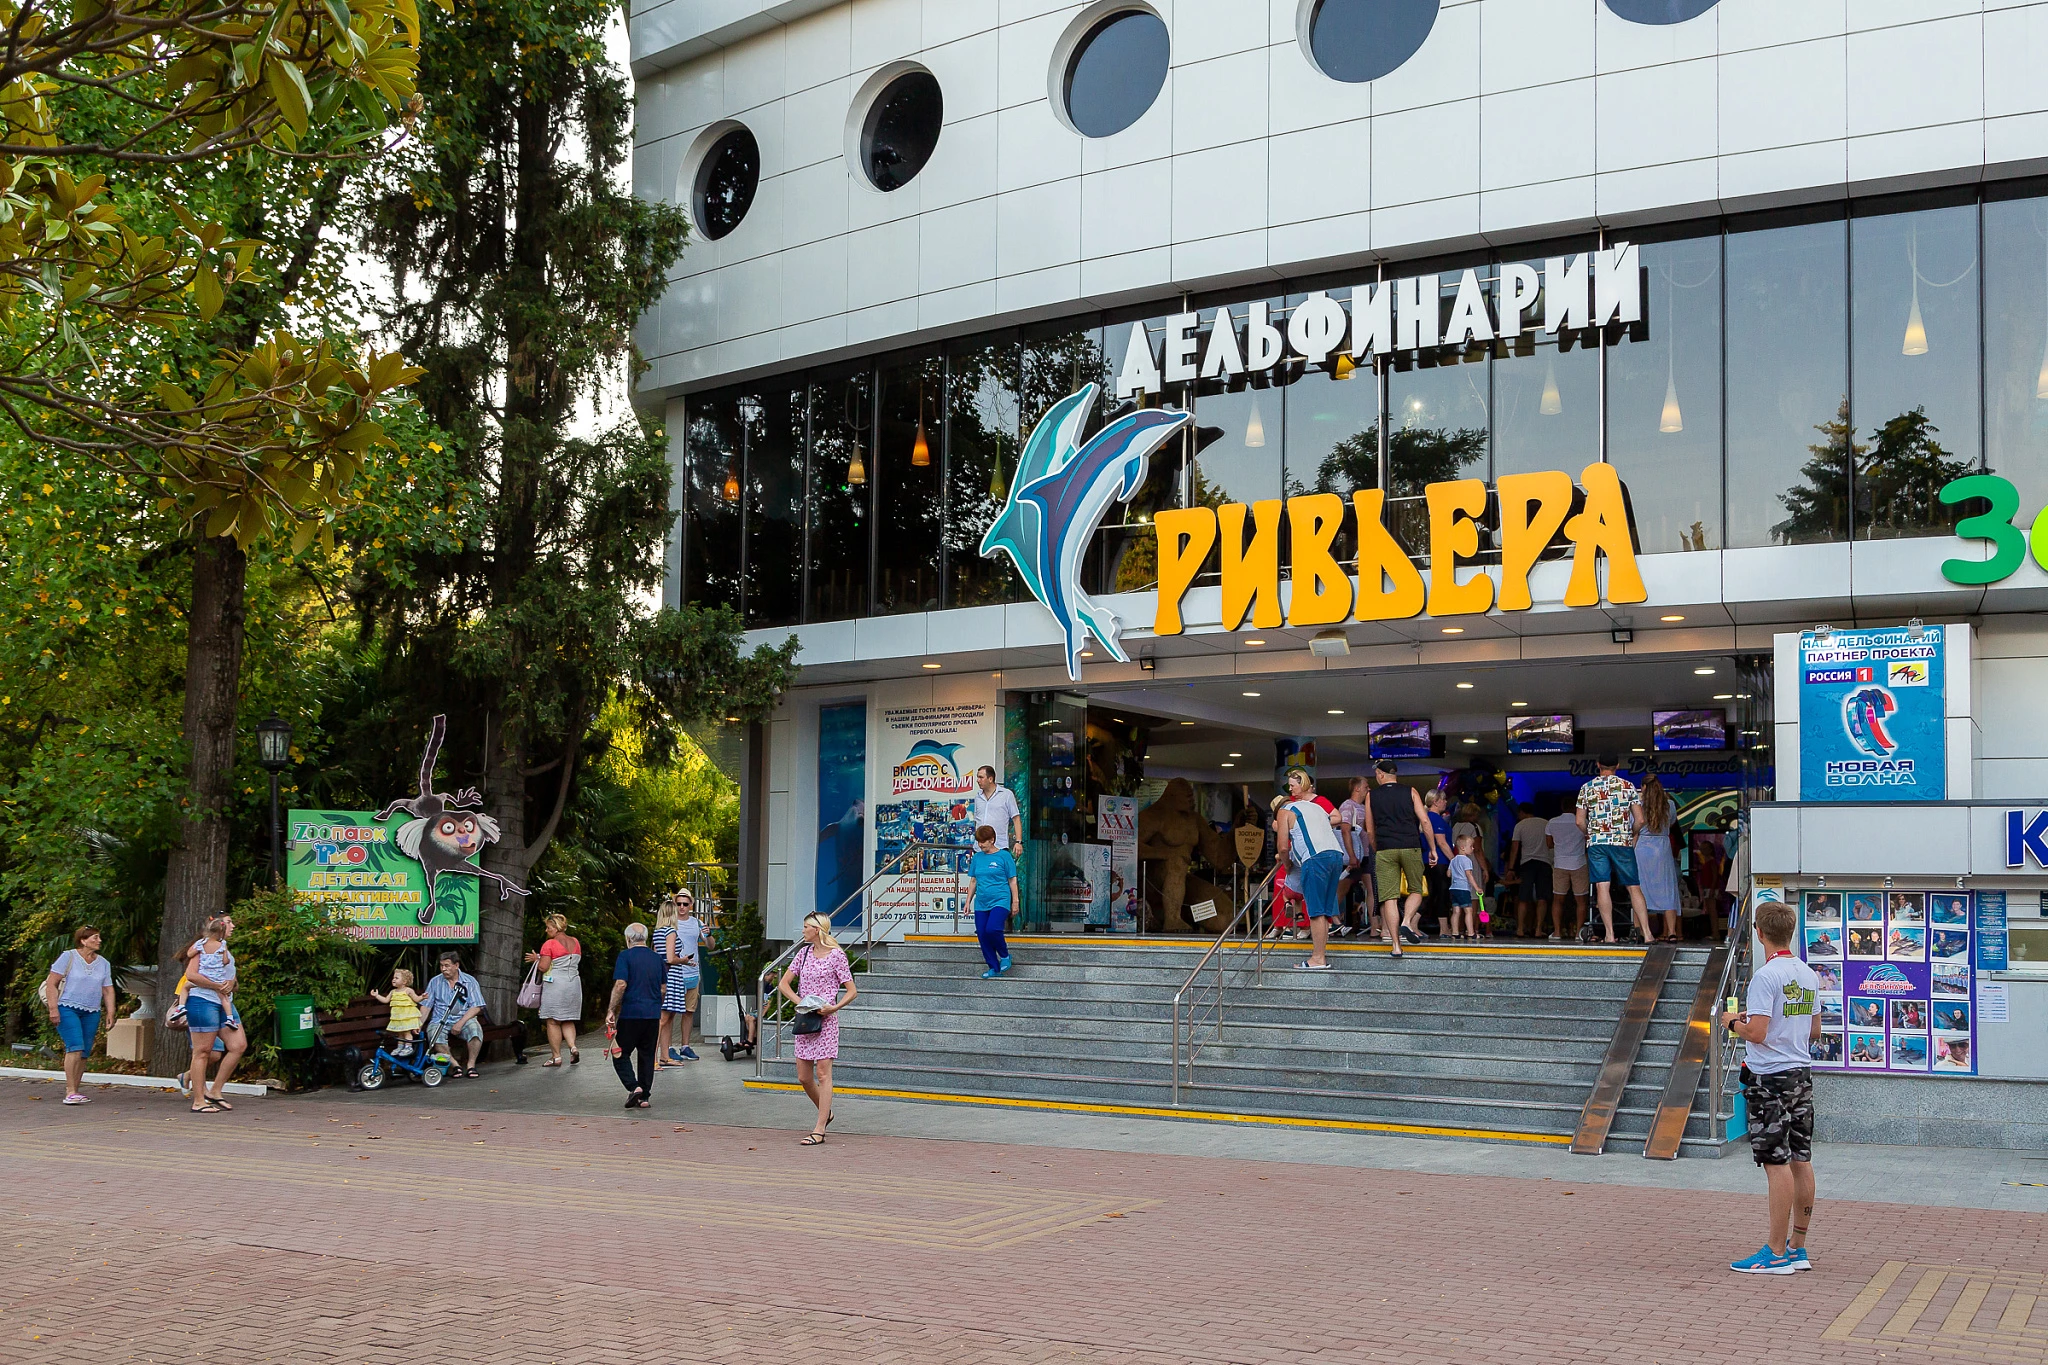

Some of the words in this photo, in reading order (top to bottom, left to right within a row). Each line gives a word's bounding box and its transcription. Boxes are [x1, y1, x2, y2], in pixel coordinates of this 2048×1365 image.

[1117, 242, 1640, 399] ДЕЛЬФИНАРИЙ
[1154, 462, 1648, 637] РИВЬЕРА
[1837, 631, 1940, 649] ДЕЛЬФИНАИЙ
[1807, 650, 1868, 663] ПАРТНЕР
[1872, 647, 1936, 660] ПРОЕКТА
[1809, 671, 1852, 682] РОССИЯ
[1859, 668, 1869, 681] 1
[884, 708, 918, 716] УВАЖАЕМЫЕ
[951, 711, 984, 719] ПРОХОДИЛИ
[914, 720, 952, 728] ПОПУЛЯРНОГО
[1629, 755, 1739, 778] Дельфинов
[1827, 760, 1914, 772] НОВАЯ
[1827, 772, 1916, 786] ВОЛНА
[309, 872, 407, 887] ДЕТСКАЯ
[389, 926, 419, 940] видов
[422, 923, 475, 939] животных!
